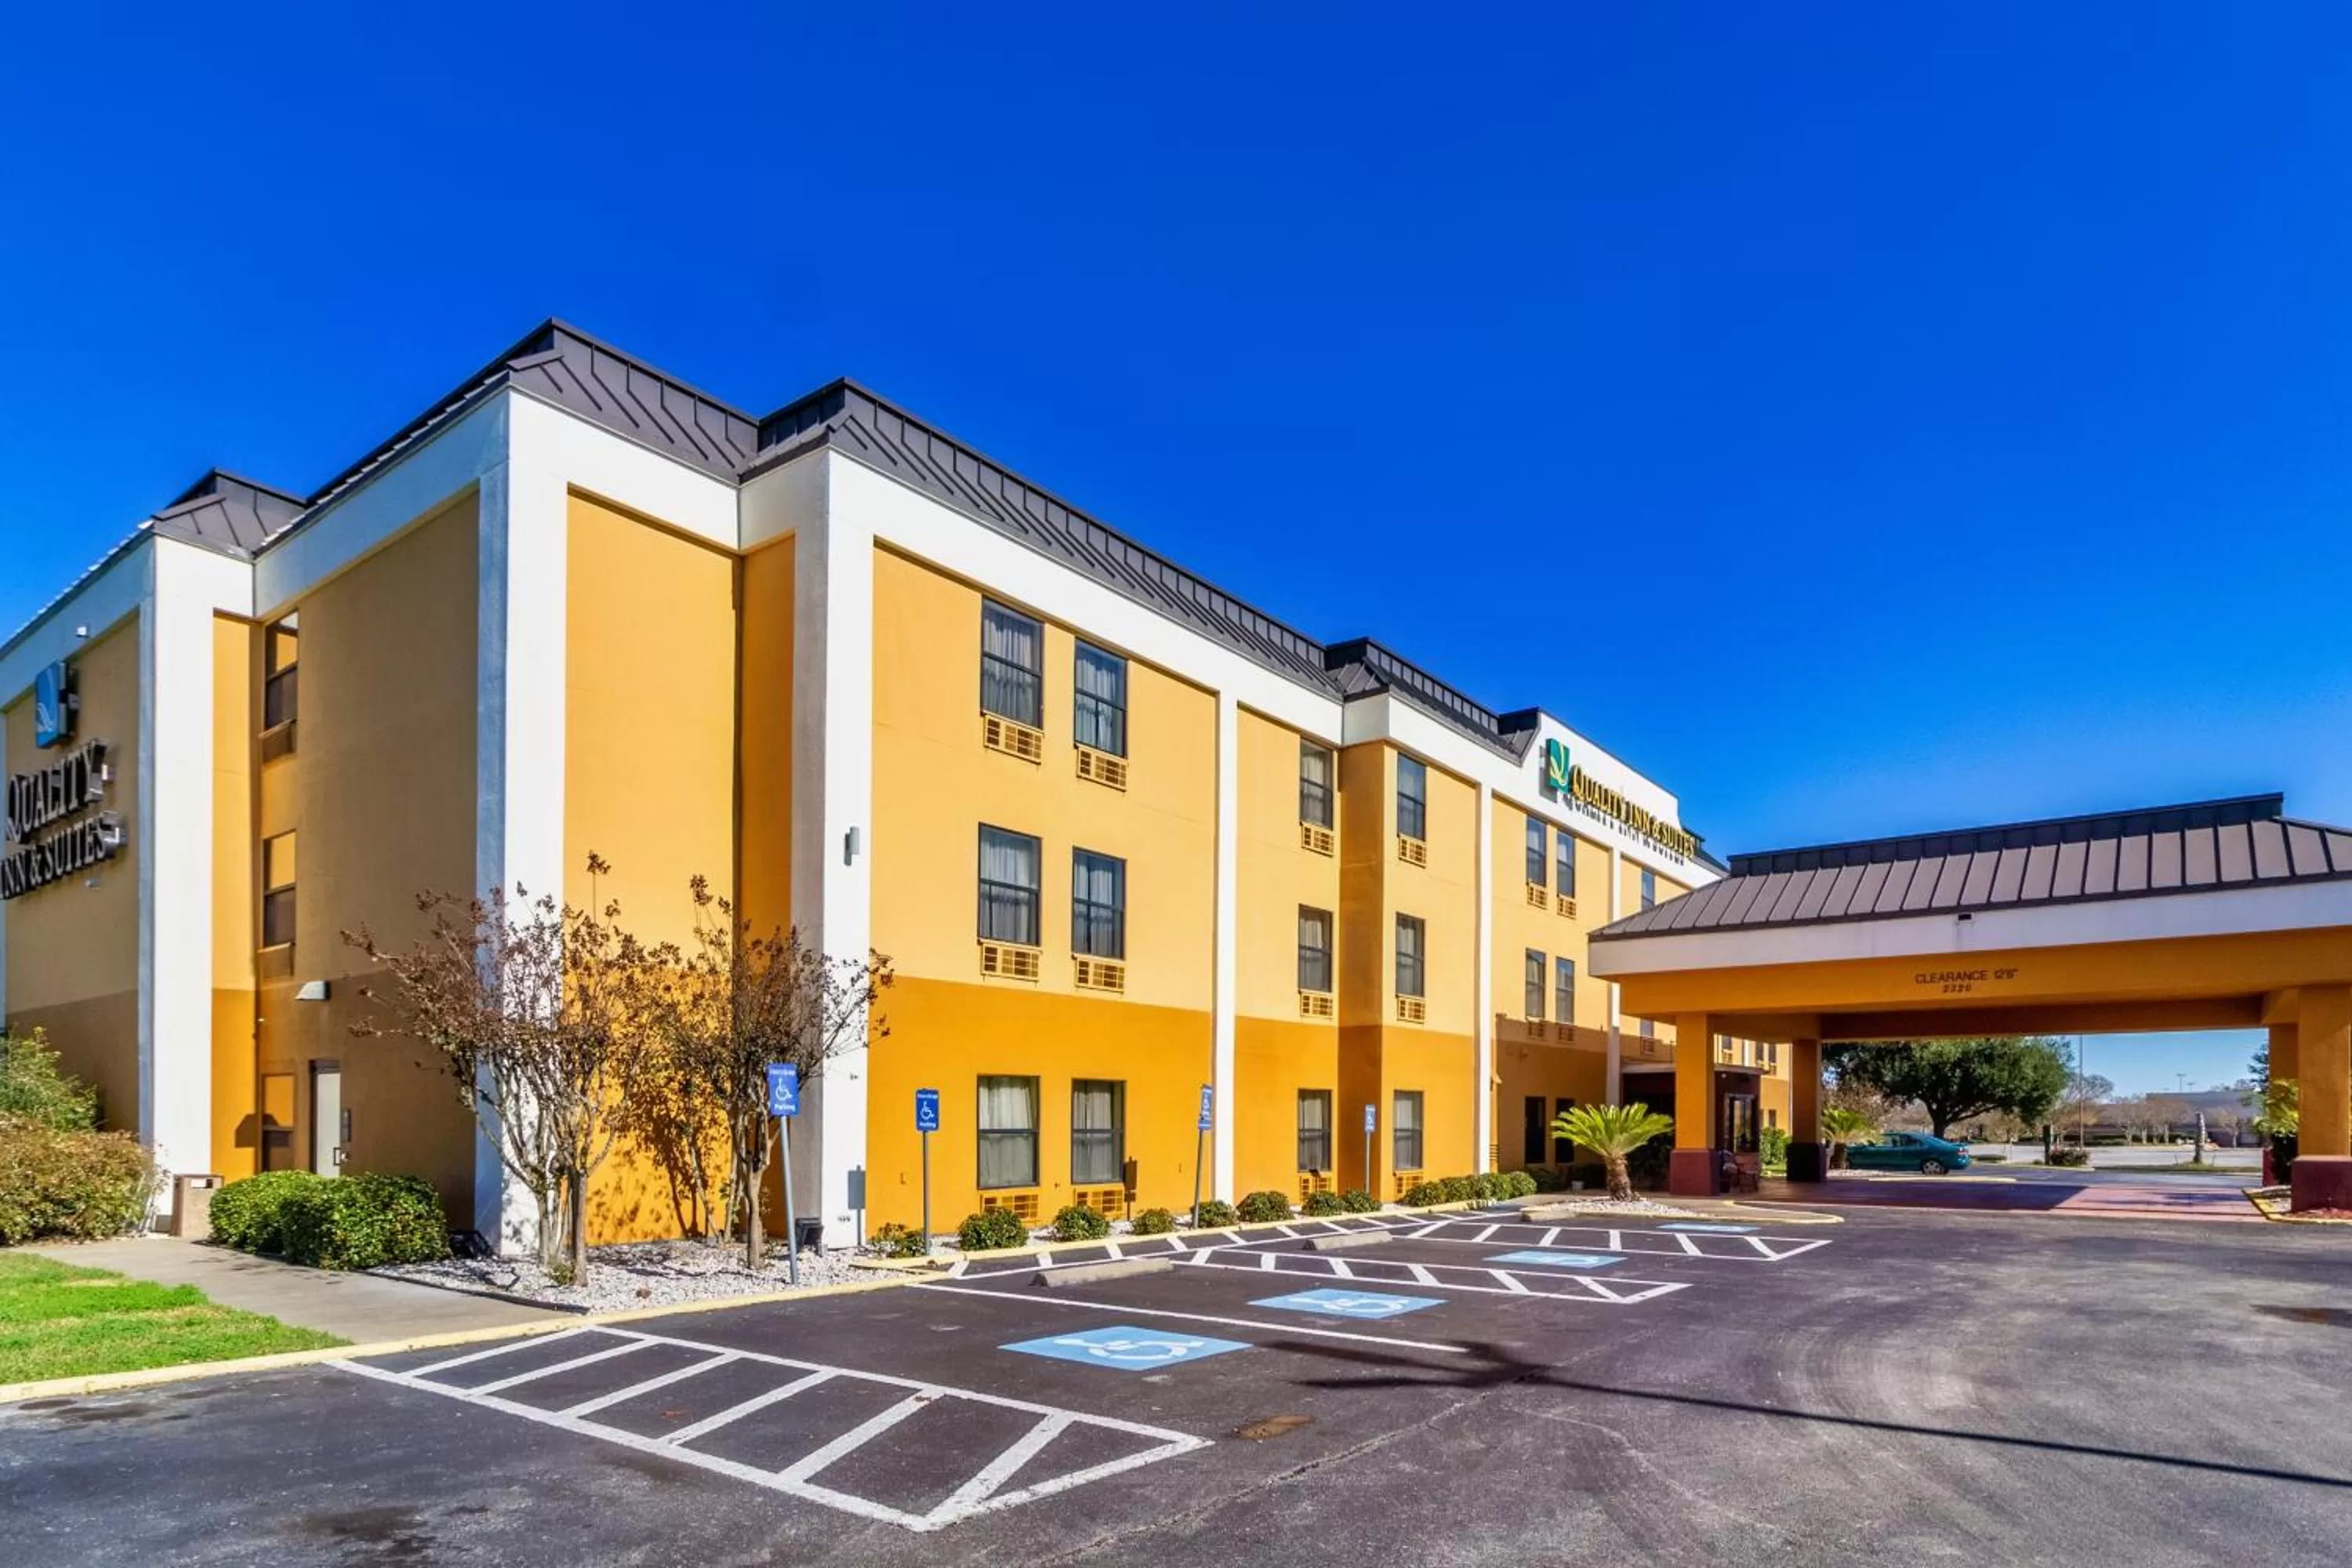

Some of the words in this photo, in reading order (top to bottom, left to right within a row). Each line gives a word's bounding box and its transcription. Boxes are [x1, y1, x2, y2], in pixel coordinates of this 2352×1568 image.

[6, 739, 102, 844] QUALITY
[1573, 765, 1625, 822] QUALITY
[1630, 802, 1650, 836] INN
[1662, 821, 1695, 858] SUITES
[29, 844, 43, 887] &
[45, 811, 112, 881] SUITES
[1915, 969, 1989, 984] CLEARANCE
